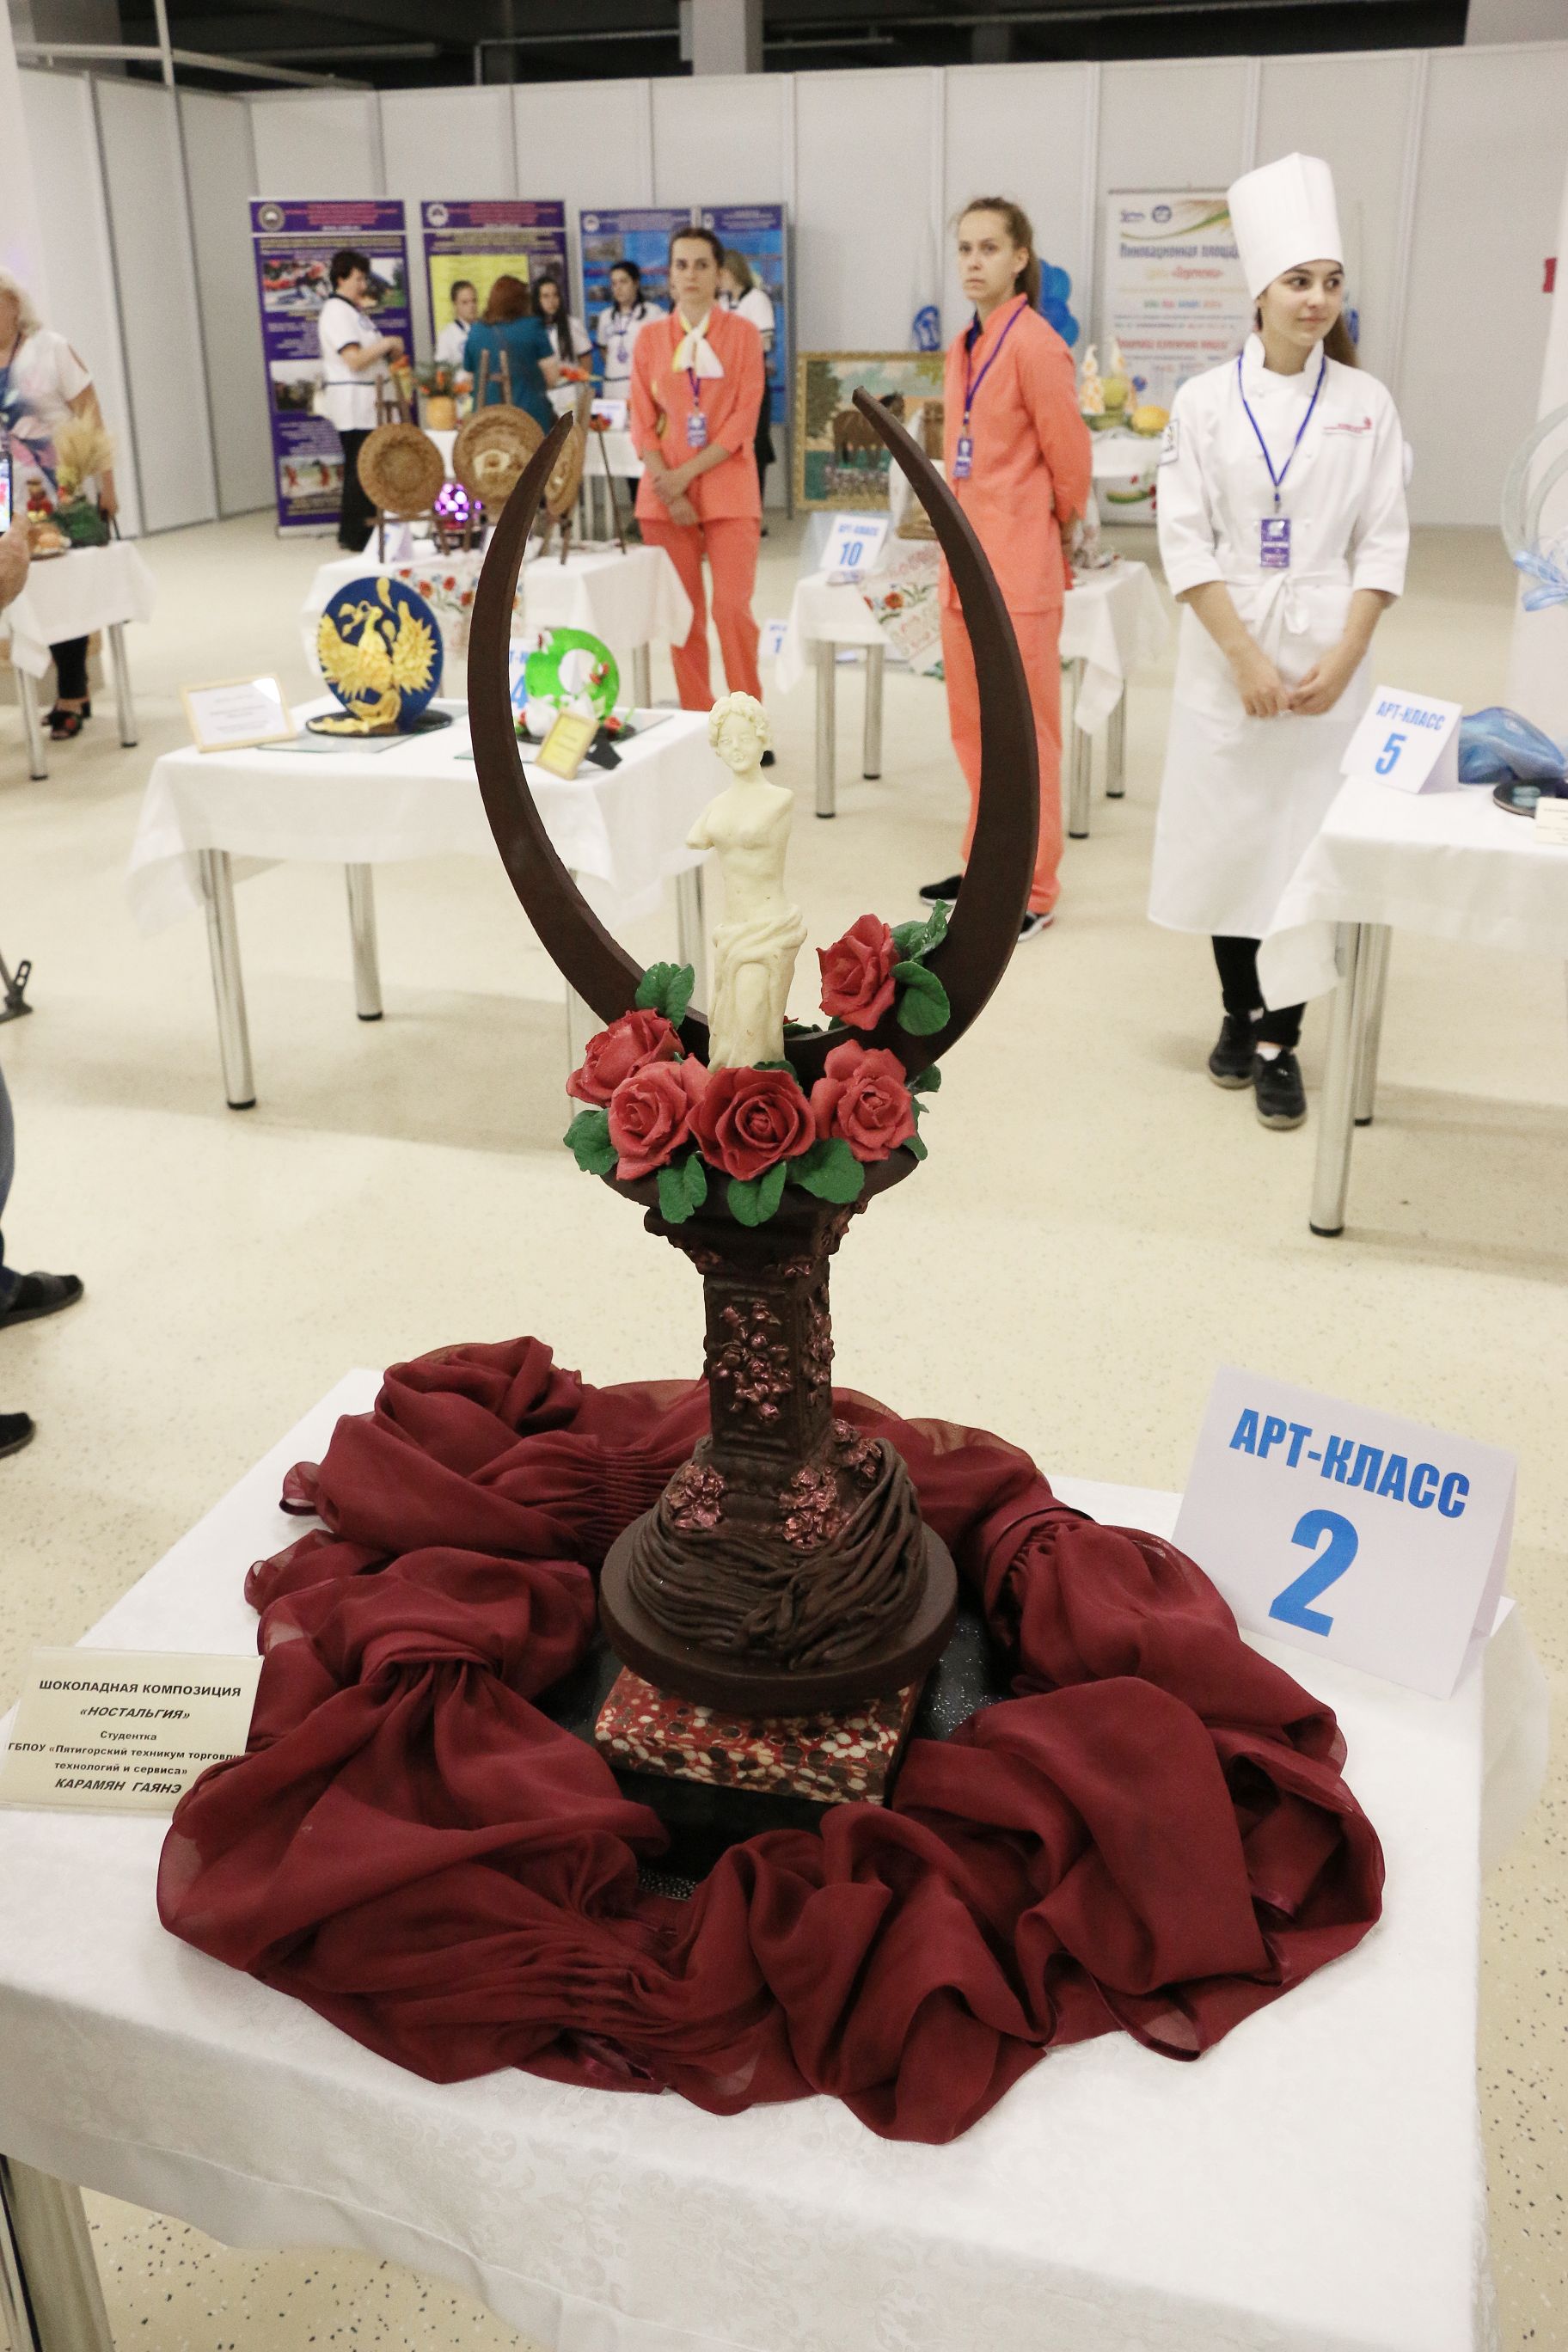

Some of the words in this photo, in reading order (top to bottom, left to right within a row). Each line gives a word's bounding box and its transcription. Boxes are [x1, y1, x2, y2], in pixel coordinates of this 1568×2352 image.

[840, 542, 863, 566] 10
[510, 675, 529, 708] 4
[1376, 701, 1446, 731] АРТ-КЛАСС
[1375, 732, 1408, 775] 5
[1229, 1408, 1471, 1519] АРТ-КЛАСС
[1268, 1509, 1359, 1638] 2
[39, 1680, 138, 1694] ШОКОЛАДНАЯ
[142, 1684, 242, 1698] КОМПОЗИЦИЯ
[80, 1706, 191, 1720] «НОСТАЛЬГИЯ»
[100, 1730, 157, 1742] Студентка
[8, 1743, 46, 1753] ГБПОУ
[49, 1744, 128, 1757] «Пятигорский
[131, 1749, 185, 1760] техникум
[54, 1761, 119, 1773] технологий
[133, 1767, 188, 1777] сервиса»
[54, 1778, 126, 1792] КАРАМЯН
[132, 1781, 183, 1794] ГАЯНЭ
